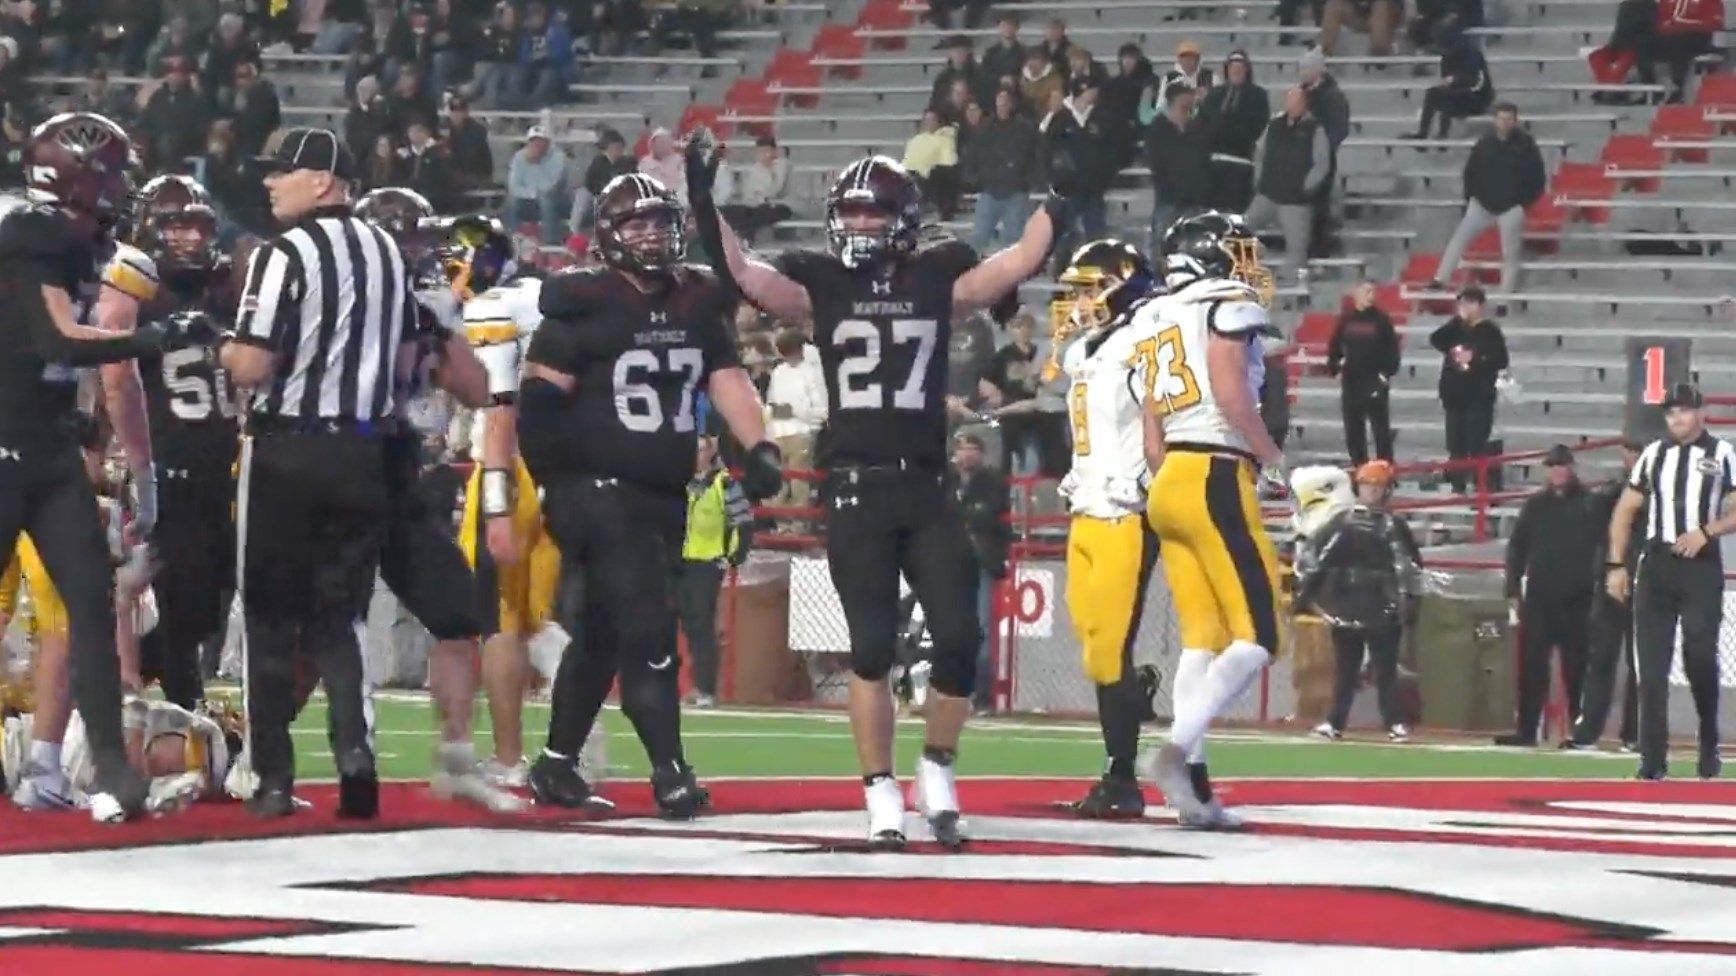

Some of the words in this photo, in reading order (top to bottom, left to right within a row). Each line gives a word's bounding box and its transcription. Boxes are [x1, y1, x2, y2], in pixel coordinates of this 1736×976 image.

[612, 347, 703, 433] 67
[832, 319, 938, 410] 27
[1642, 346, 1667, 404] 1
